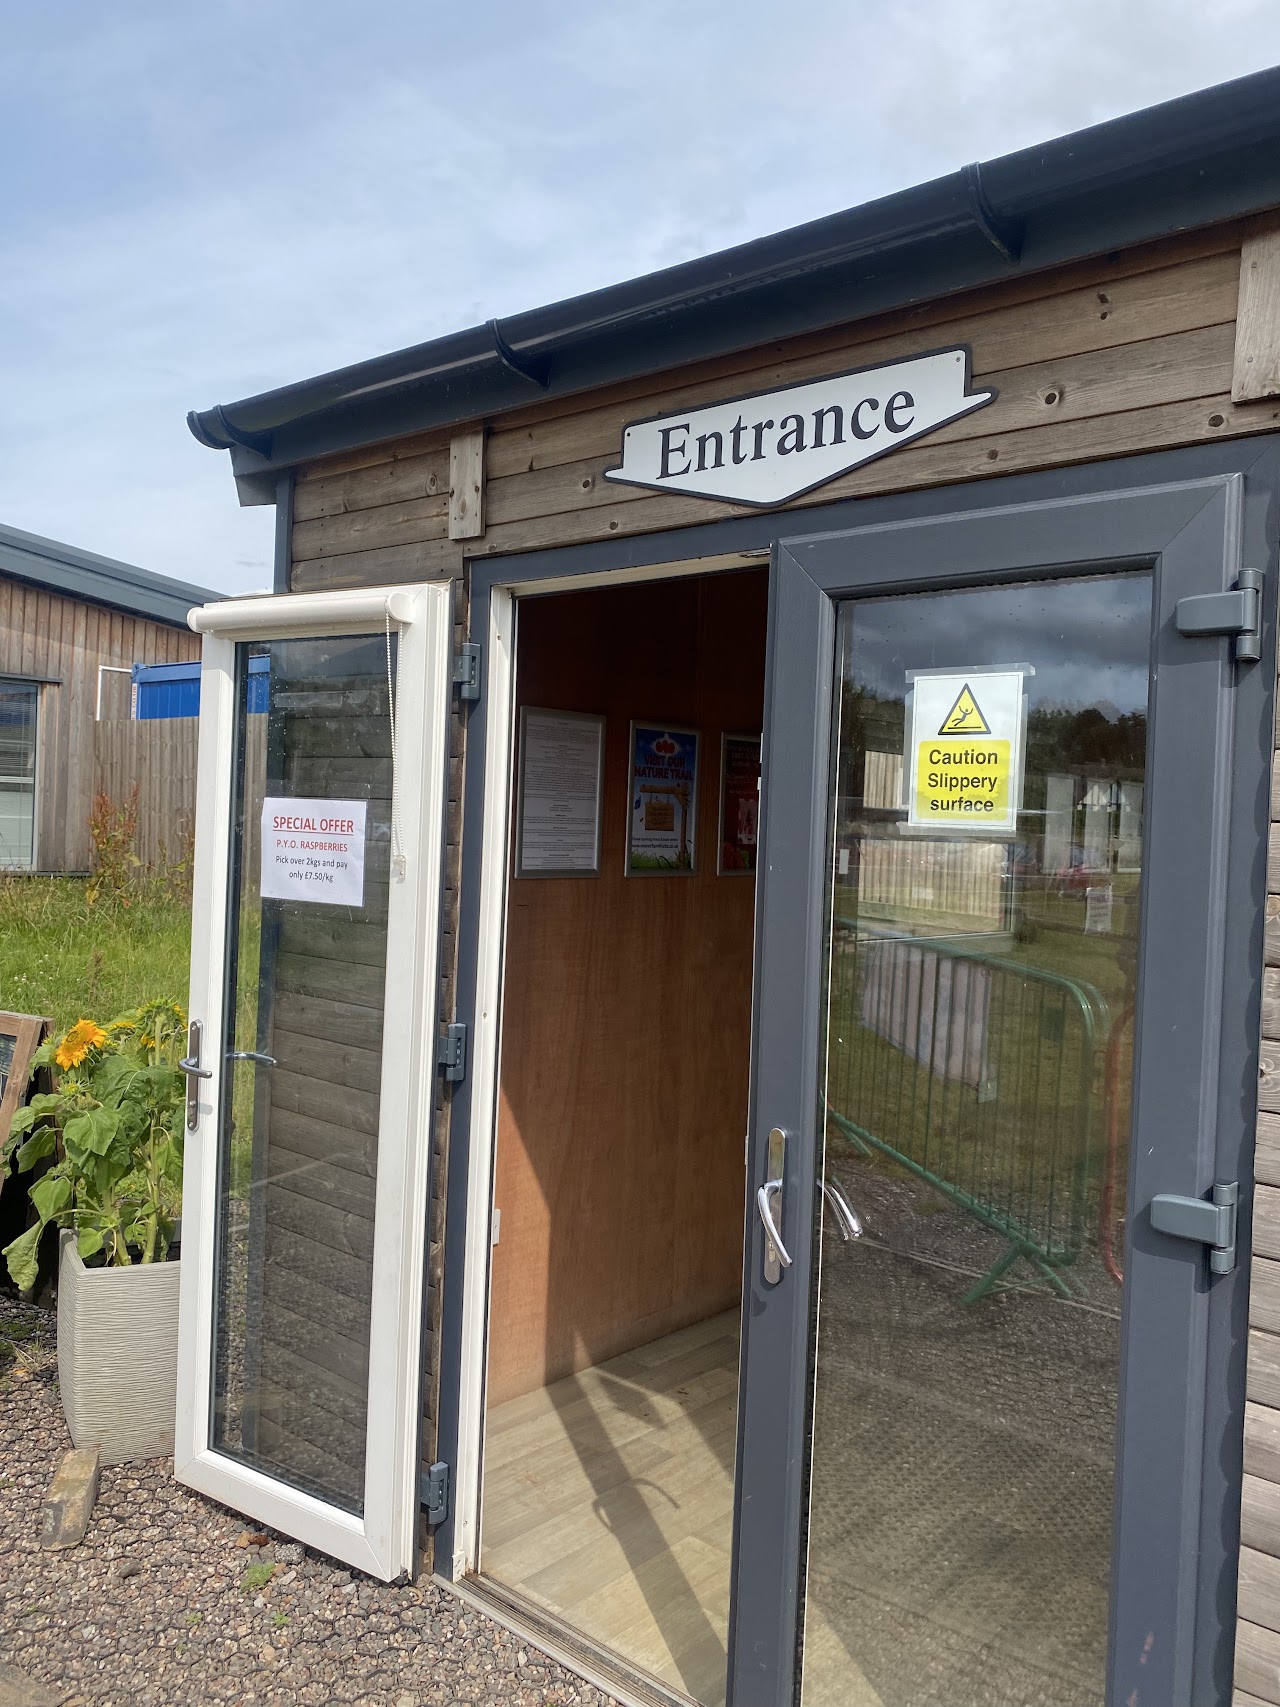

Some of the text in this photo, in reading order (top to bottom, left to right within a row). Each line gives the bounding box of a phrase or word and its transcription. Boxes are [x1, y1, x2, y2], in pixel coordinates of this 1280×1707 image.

[656, 390, 915, 480] Entrance
[644, 754, 686, 768] VISIT OUR
[929, 749, 998, 765] Caution
[634, 765, 694, 781] NATURE TRAIL
[927, 773, 998, 792] Slippery
[930, 797, 994, 811] surface
[273, 816, 354, 833] SPECIAL OFFER
[276, 839, 348, 852] P.Y.O. RASPBERRIES
[276, 855, 289, 864] Pick
[306, 857, 321, 868] 2kgs
[322, 859, 335, 867] and
[336, 861, 348, 869] pay
[289, 870, 334, 884] only £7.50/kg
